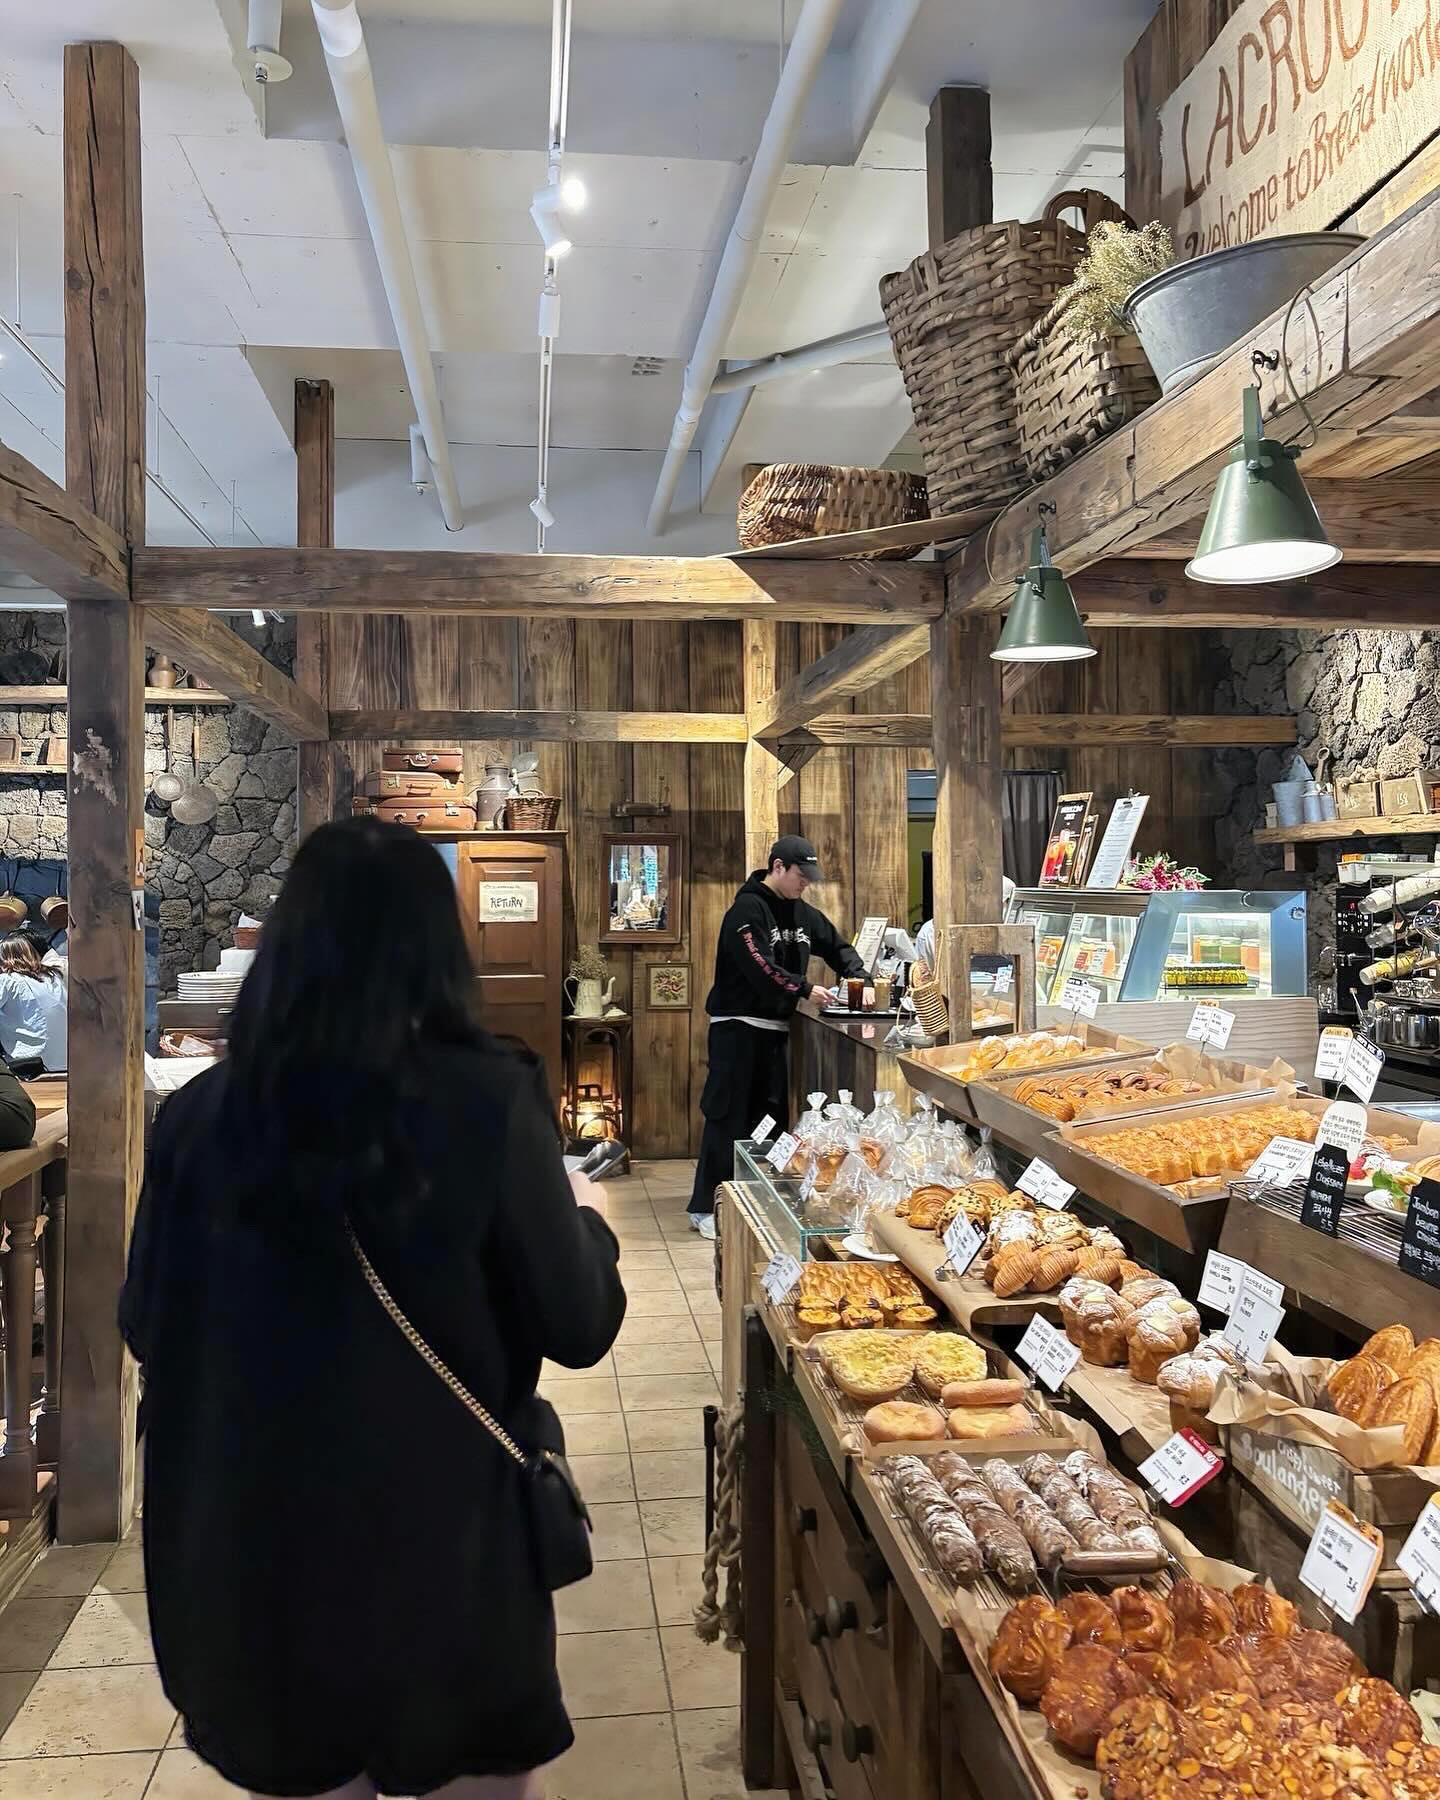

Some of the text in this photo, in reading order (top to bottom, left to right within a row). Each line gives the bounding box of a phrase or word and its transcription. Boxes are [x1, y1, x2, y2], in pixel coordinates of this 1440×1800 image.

[1283, 148, 1312, 210] to
[1310, 49, 1381, 193] Bread
[490, 896, 524, 909] RETURN
